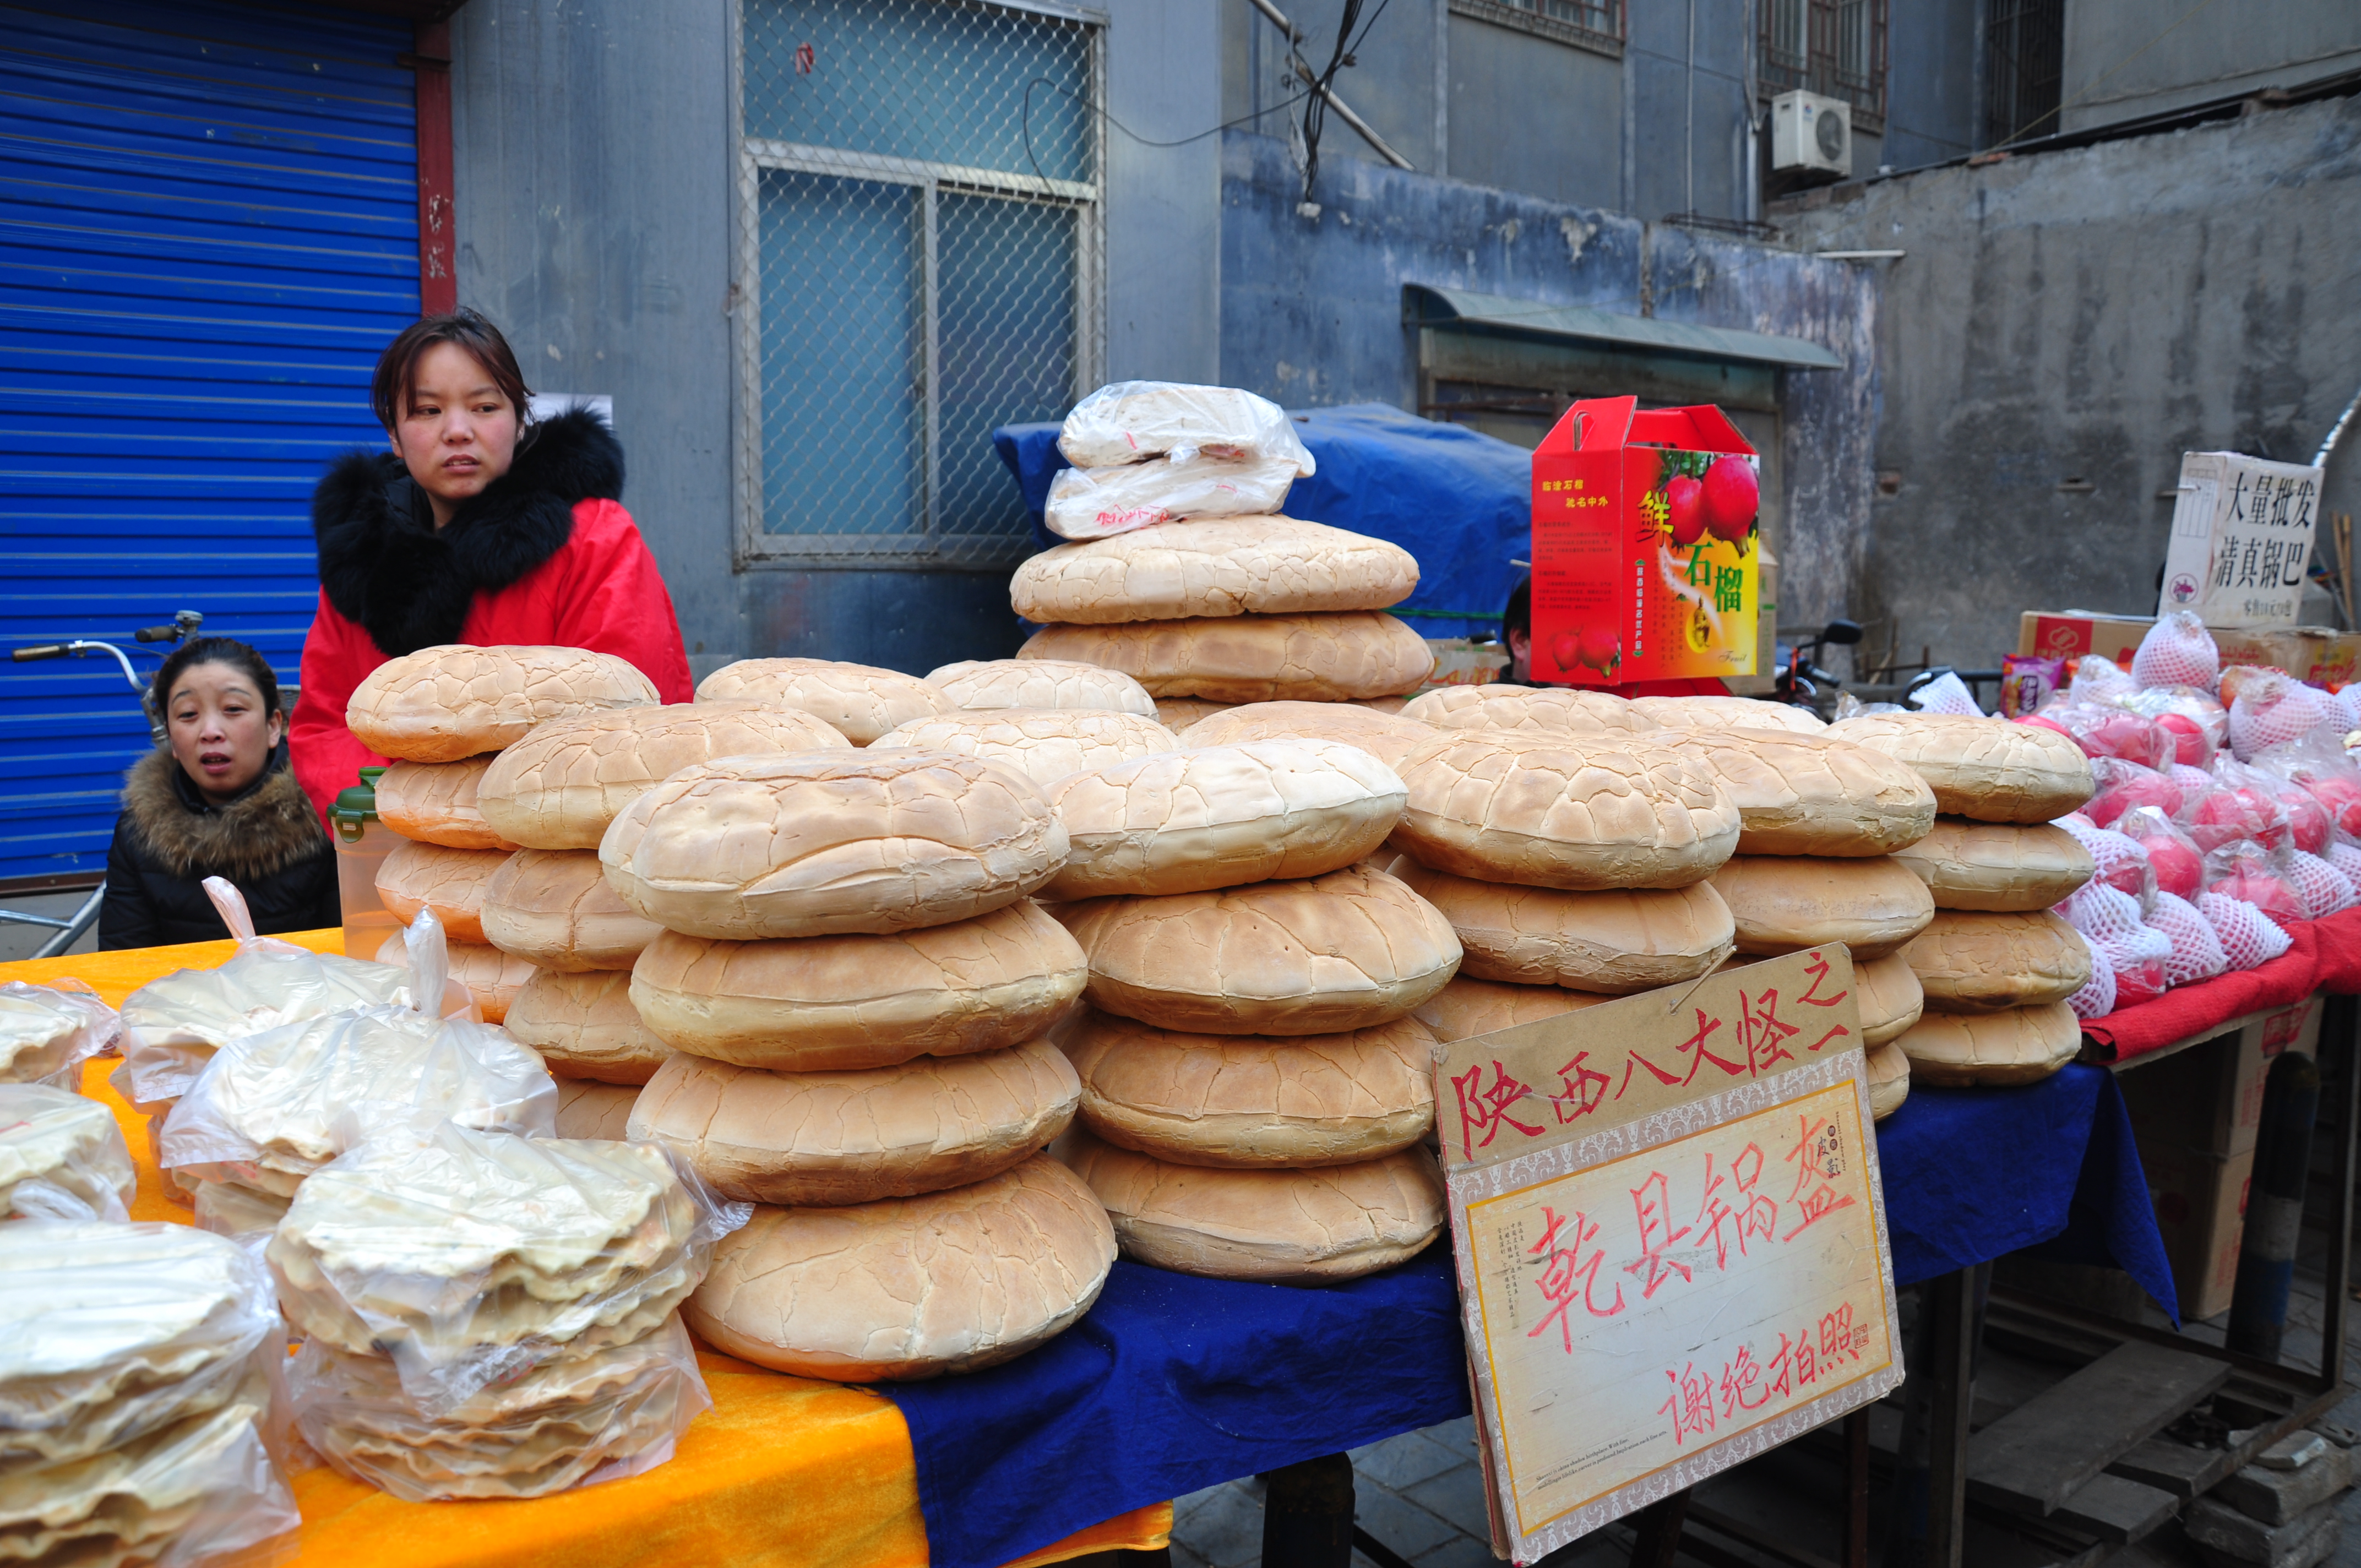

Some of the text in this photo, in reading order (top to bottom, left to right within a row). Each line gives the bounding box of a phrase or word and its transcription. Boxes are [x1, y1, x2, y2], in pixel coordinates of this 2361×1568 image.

[1542, 479, 1584, 491] 临潼石榴
[1565, 496, 1608, 508] 驰名中外
[2226, 471, 2316, 529] 大量批发
[1636, 490, 1674, 548] 鲜
[1684, 541, 1744, 613] 石榴
[2215, 536, 2304, 589] 清真锅巴
[1718, 651, 1747, 662] Fruit
[1451, 952, 1848, 1162] 陕西八大怪之一
[1528, 1114, 1857, 1353] 乾县锅盔
[1658, 1302, 1860, 1445] 谢绝拍照
[1570, 1457, 1585, 1467] shadow
